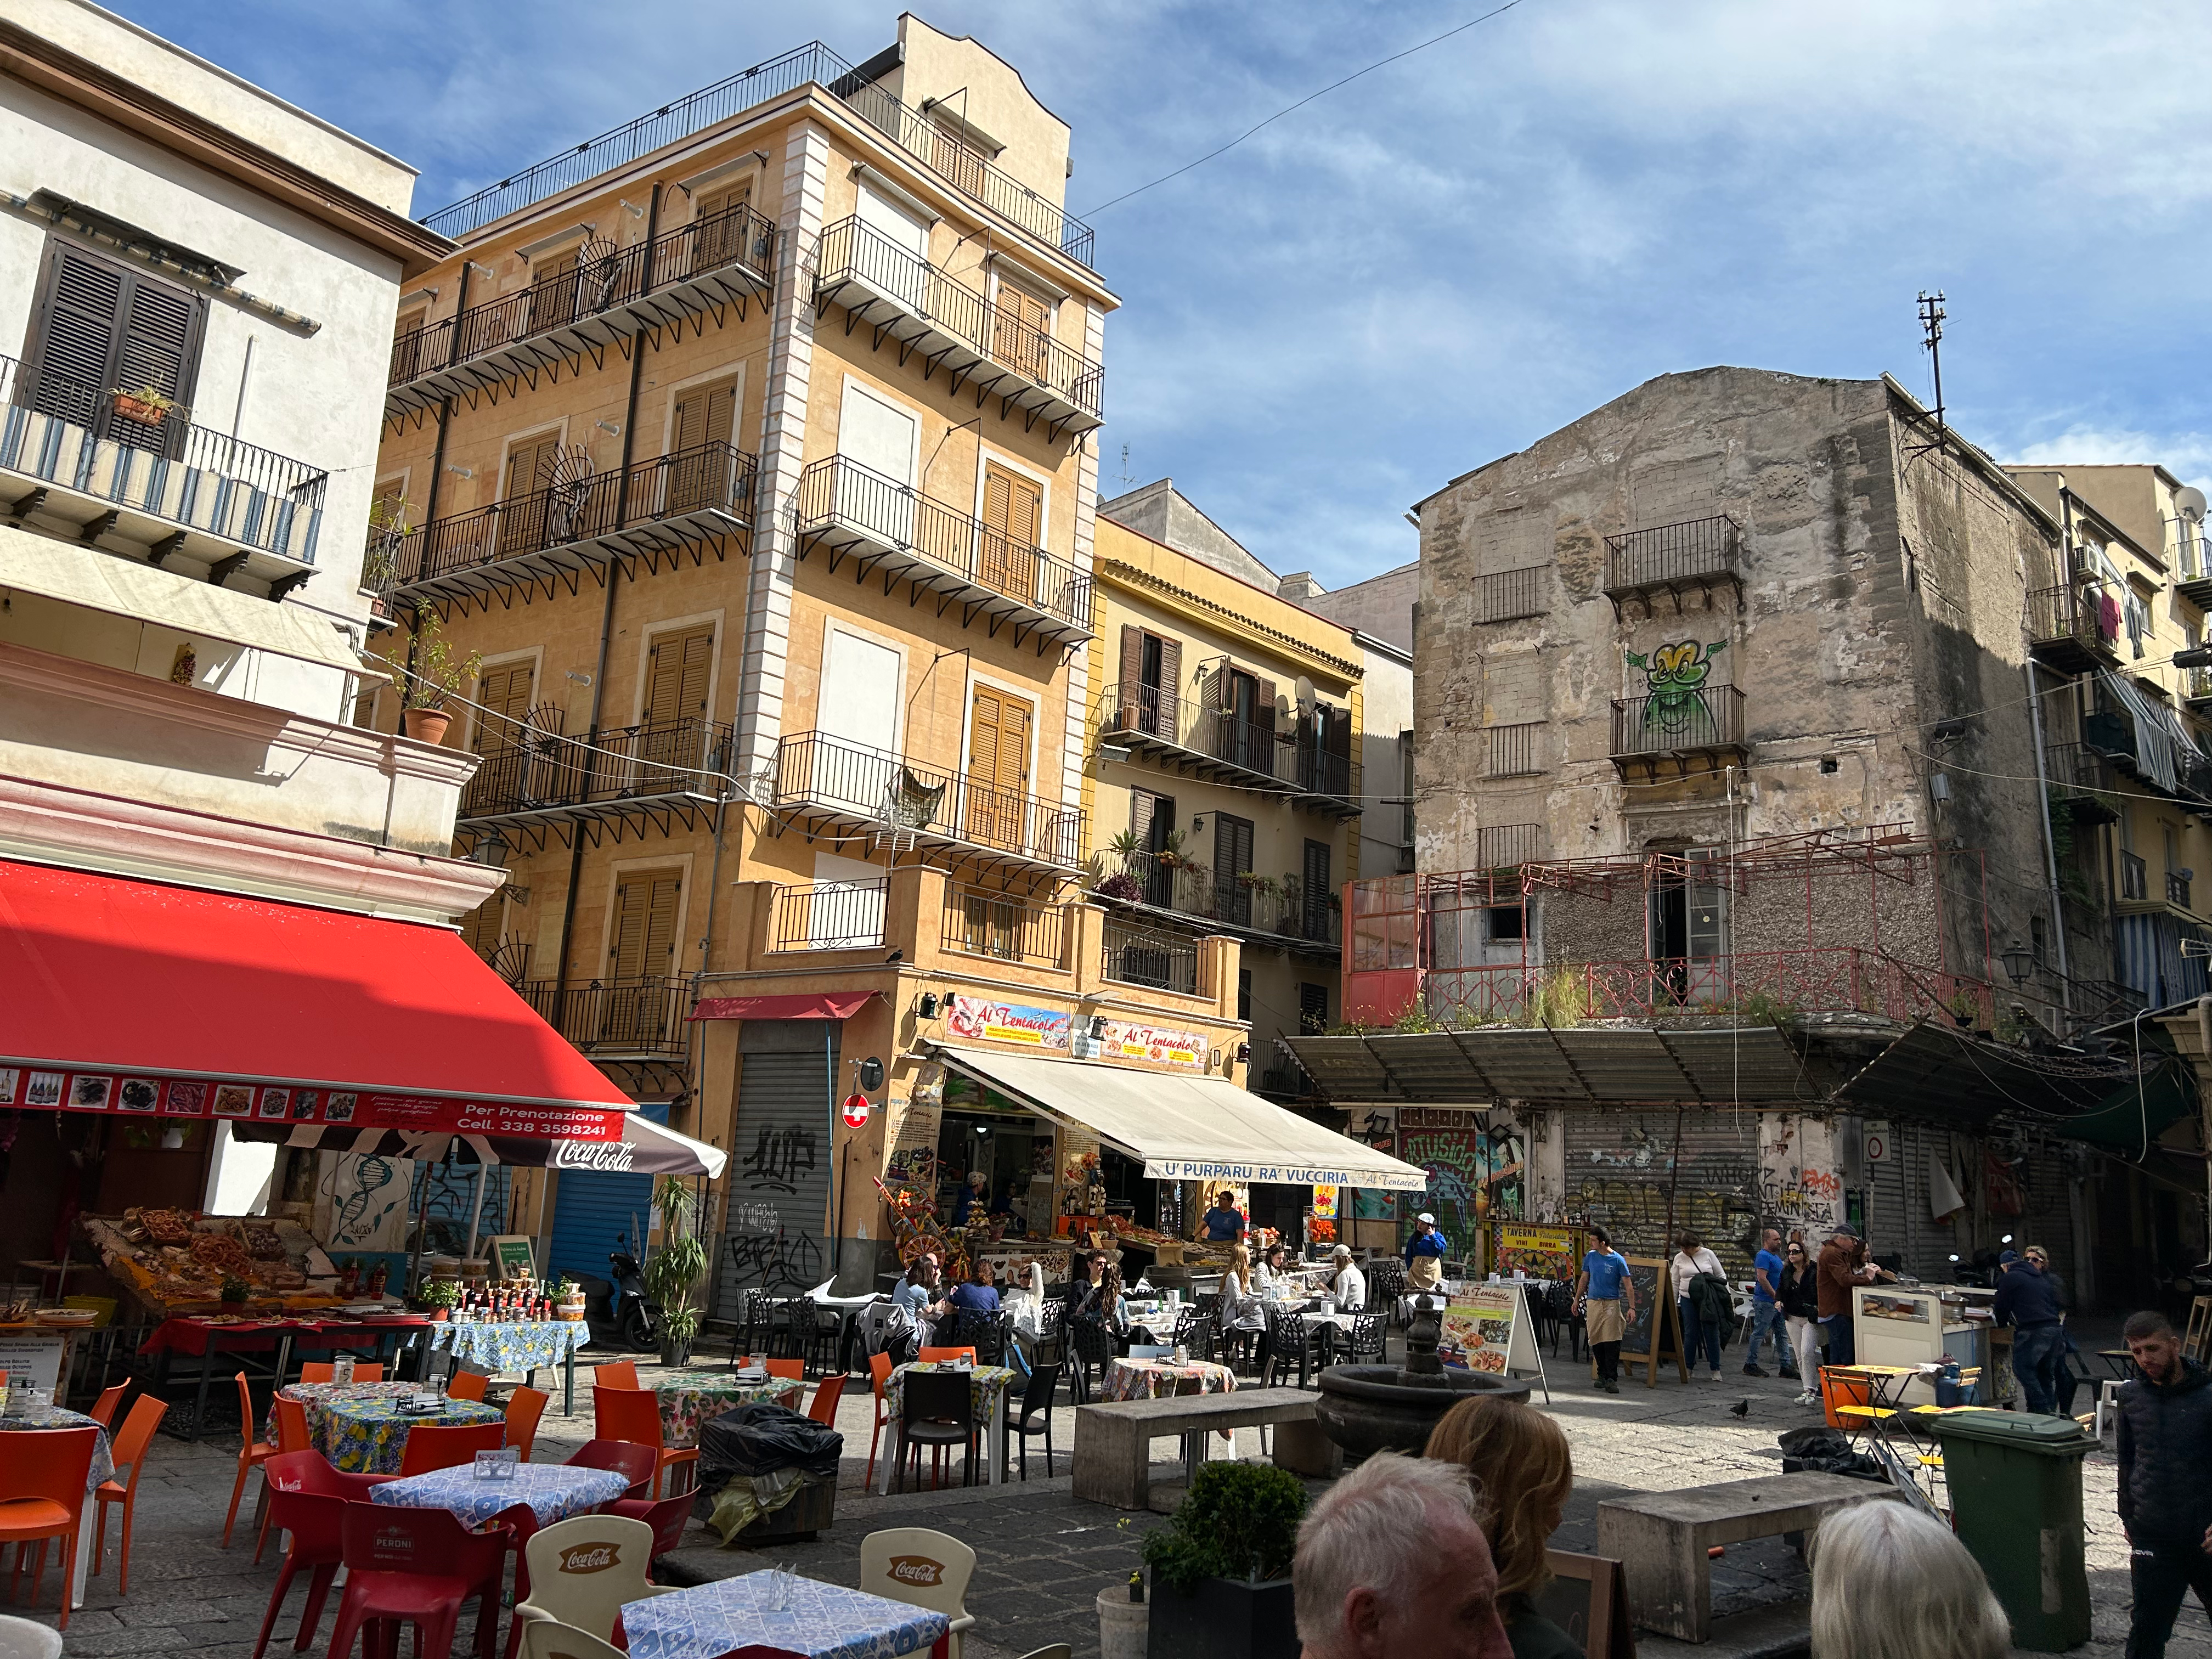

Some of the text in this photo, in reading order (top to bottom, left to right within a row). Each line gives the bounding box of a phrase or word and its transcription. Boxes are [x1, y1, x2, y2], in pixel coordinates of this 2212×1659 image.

[975, 1005, 1055, 1032] Al Tentacolo
[1122, 1028, 1137, 1044] Al
[1141, 1030, 1190, 1051] Tentacolo
[465, 1104, 605, 1122] Per Prenotazione
[457, 1119, 606, 1136] Cell. 338 3598241
[1372, 1138, 1392, 1149] PUB
[556, 1139, 637, 1172] Coca-Cola
[1183, 1163, 1252, 1178] PURPARU
[1286, 1169, 1348, 1184] VUCCIRIA
[1365, 1174, 1419, 1188] Al Tentacolo
[1506, 1228, 1537, 1238] TAVERNA
[1471, 1287, 1510, 1301] Tentacolo
[343, 1368, 351, 1381] 5
[376, 1539, 411, 1548] PERONI
[567, 1547, 612, 1569] Coca-Cola
[895, 1561, 938, 1582] Coca-Cola
